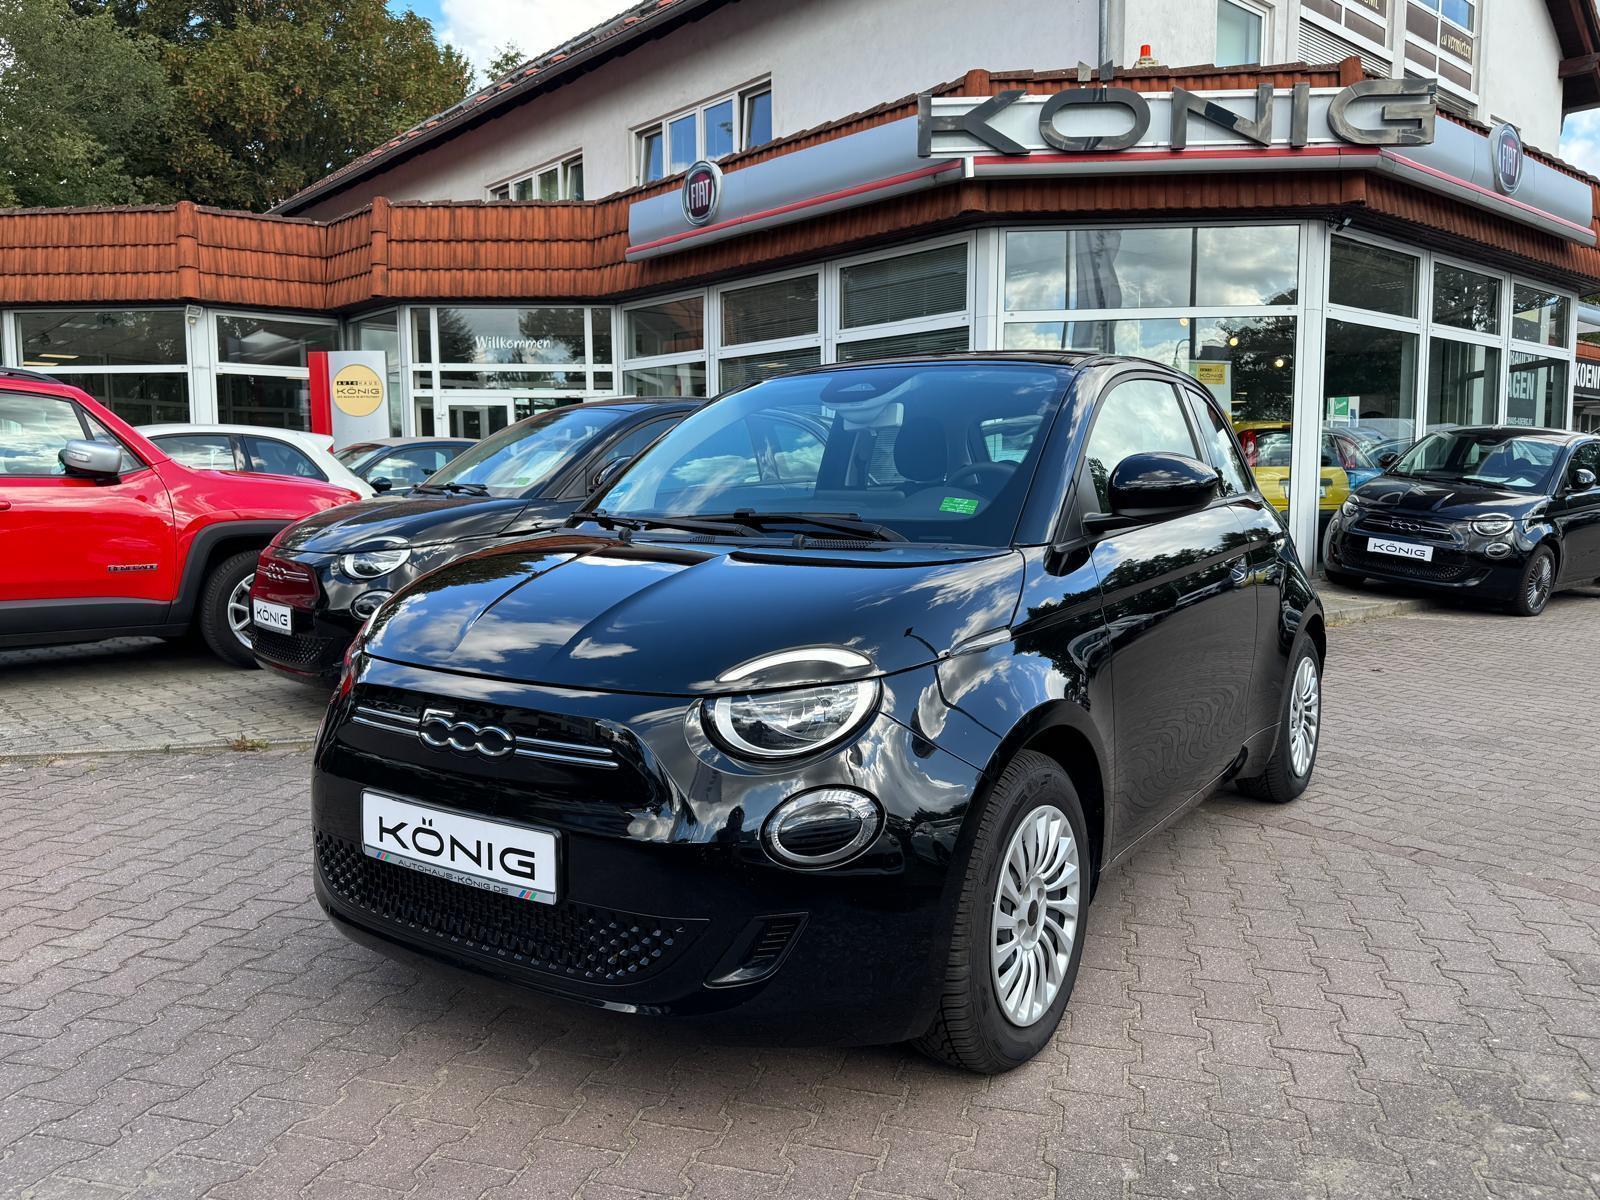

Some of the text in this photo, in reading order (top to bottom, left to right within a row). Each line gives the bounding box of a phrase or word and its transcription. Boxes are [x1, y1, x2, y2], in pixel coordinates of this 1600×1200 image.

[916, 60, 1437, 158] KÖNIG
[1502, 143, 1517, 176] FIAT
[690, 179, 710, 209] FIAT
[475, 335, 551, 349] Willkommen
[337, 387, 380, 395] KÖNIG
[1373, 542, 1426, 558] KÖNIG
[256, 605, 288, 626] KÖNIG
[420, 708, 515, 756] 500
[378, 815, 536, 881] KÖNIG
